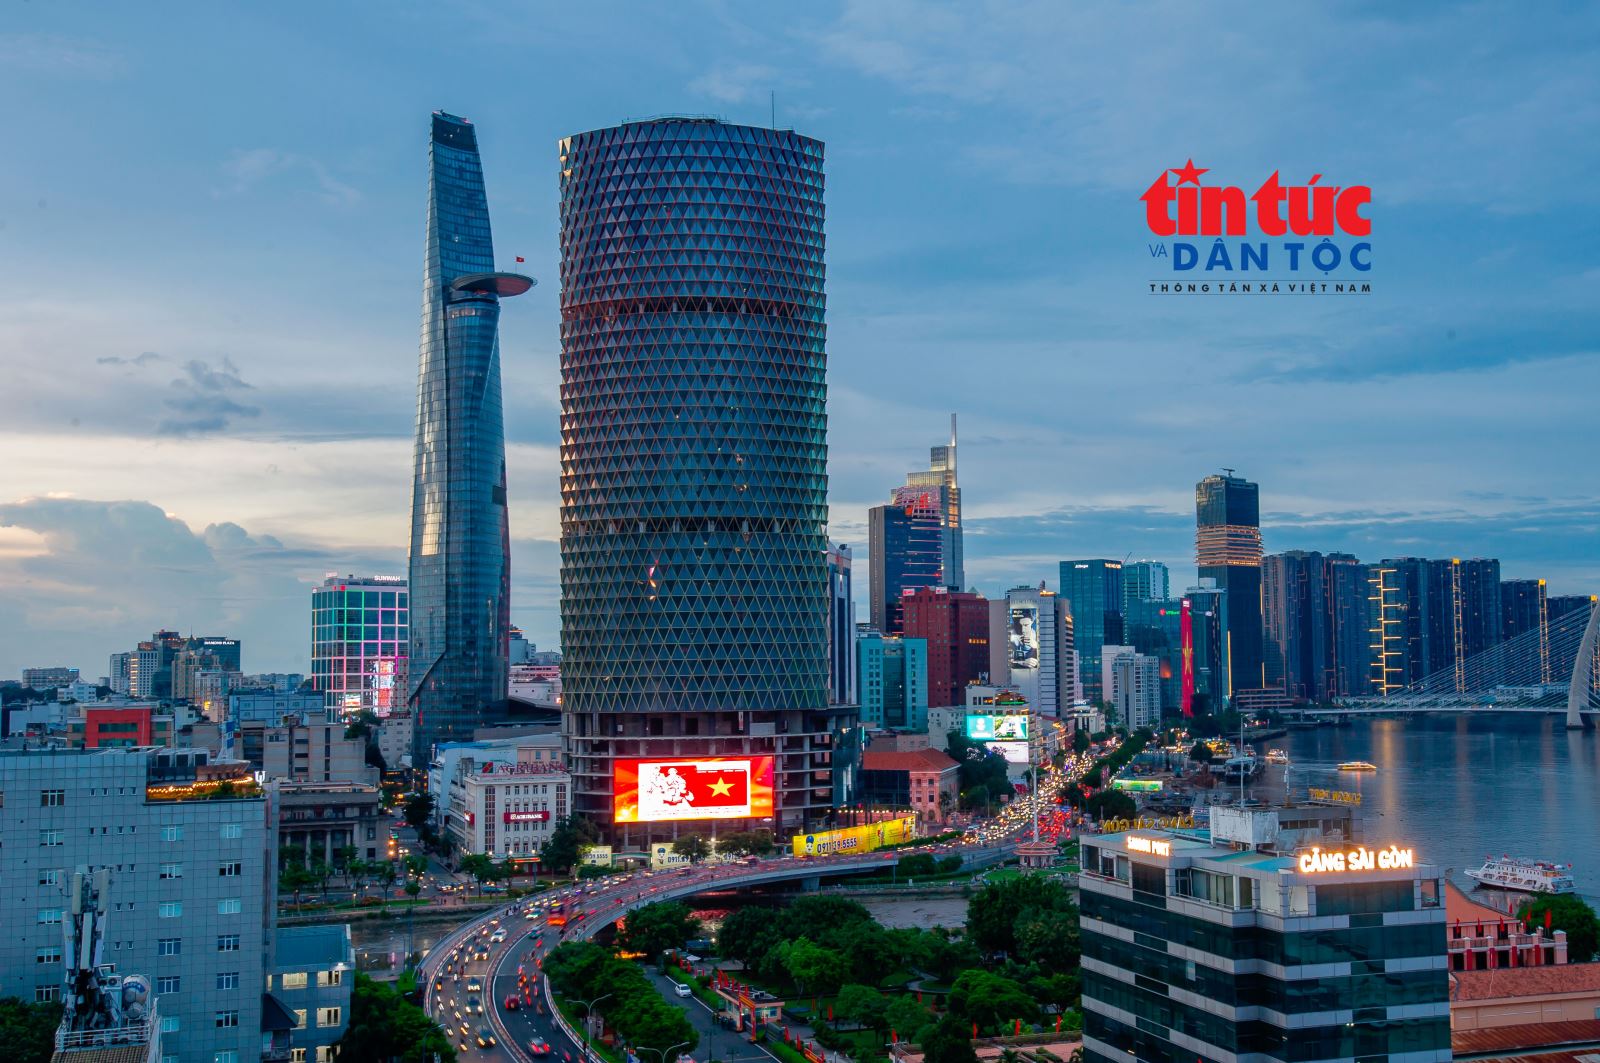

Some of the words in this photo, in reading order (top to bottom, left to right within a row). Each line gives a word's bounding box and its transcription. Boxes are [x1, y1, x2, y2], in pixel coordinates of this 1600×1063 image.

[1299, 847, 1345, 872] CẢNG
[1348, 847, 1375, 870] SÀI
[1378, 845, 1413, 869] GÒN
